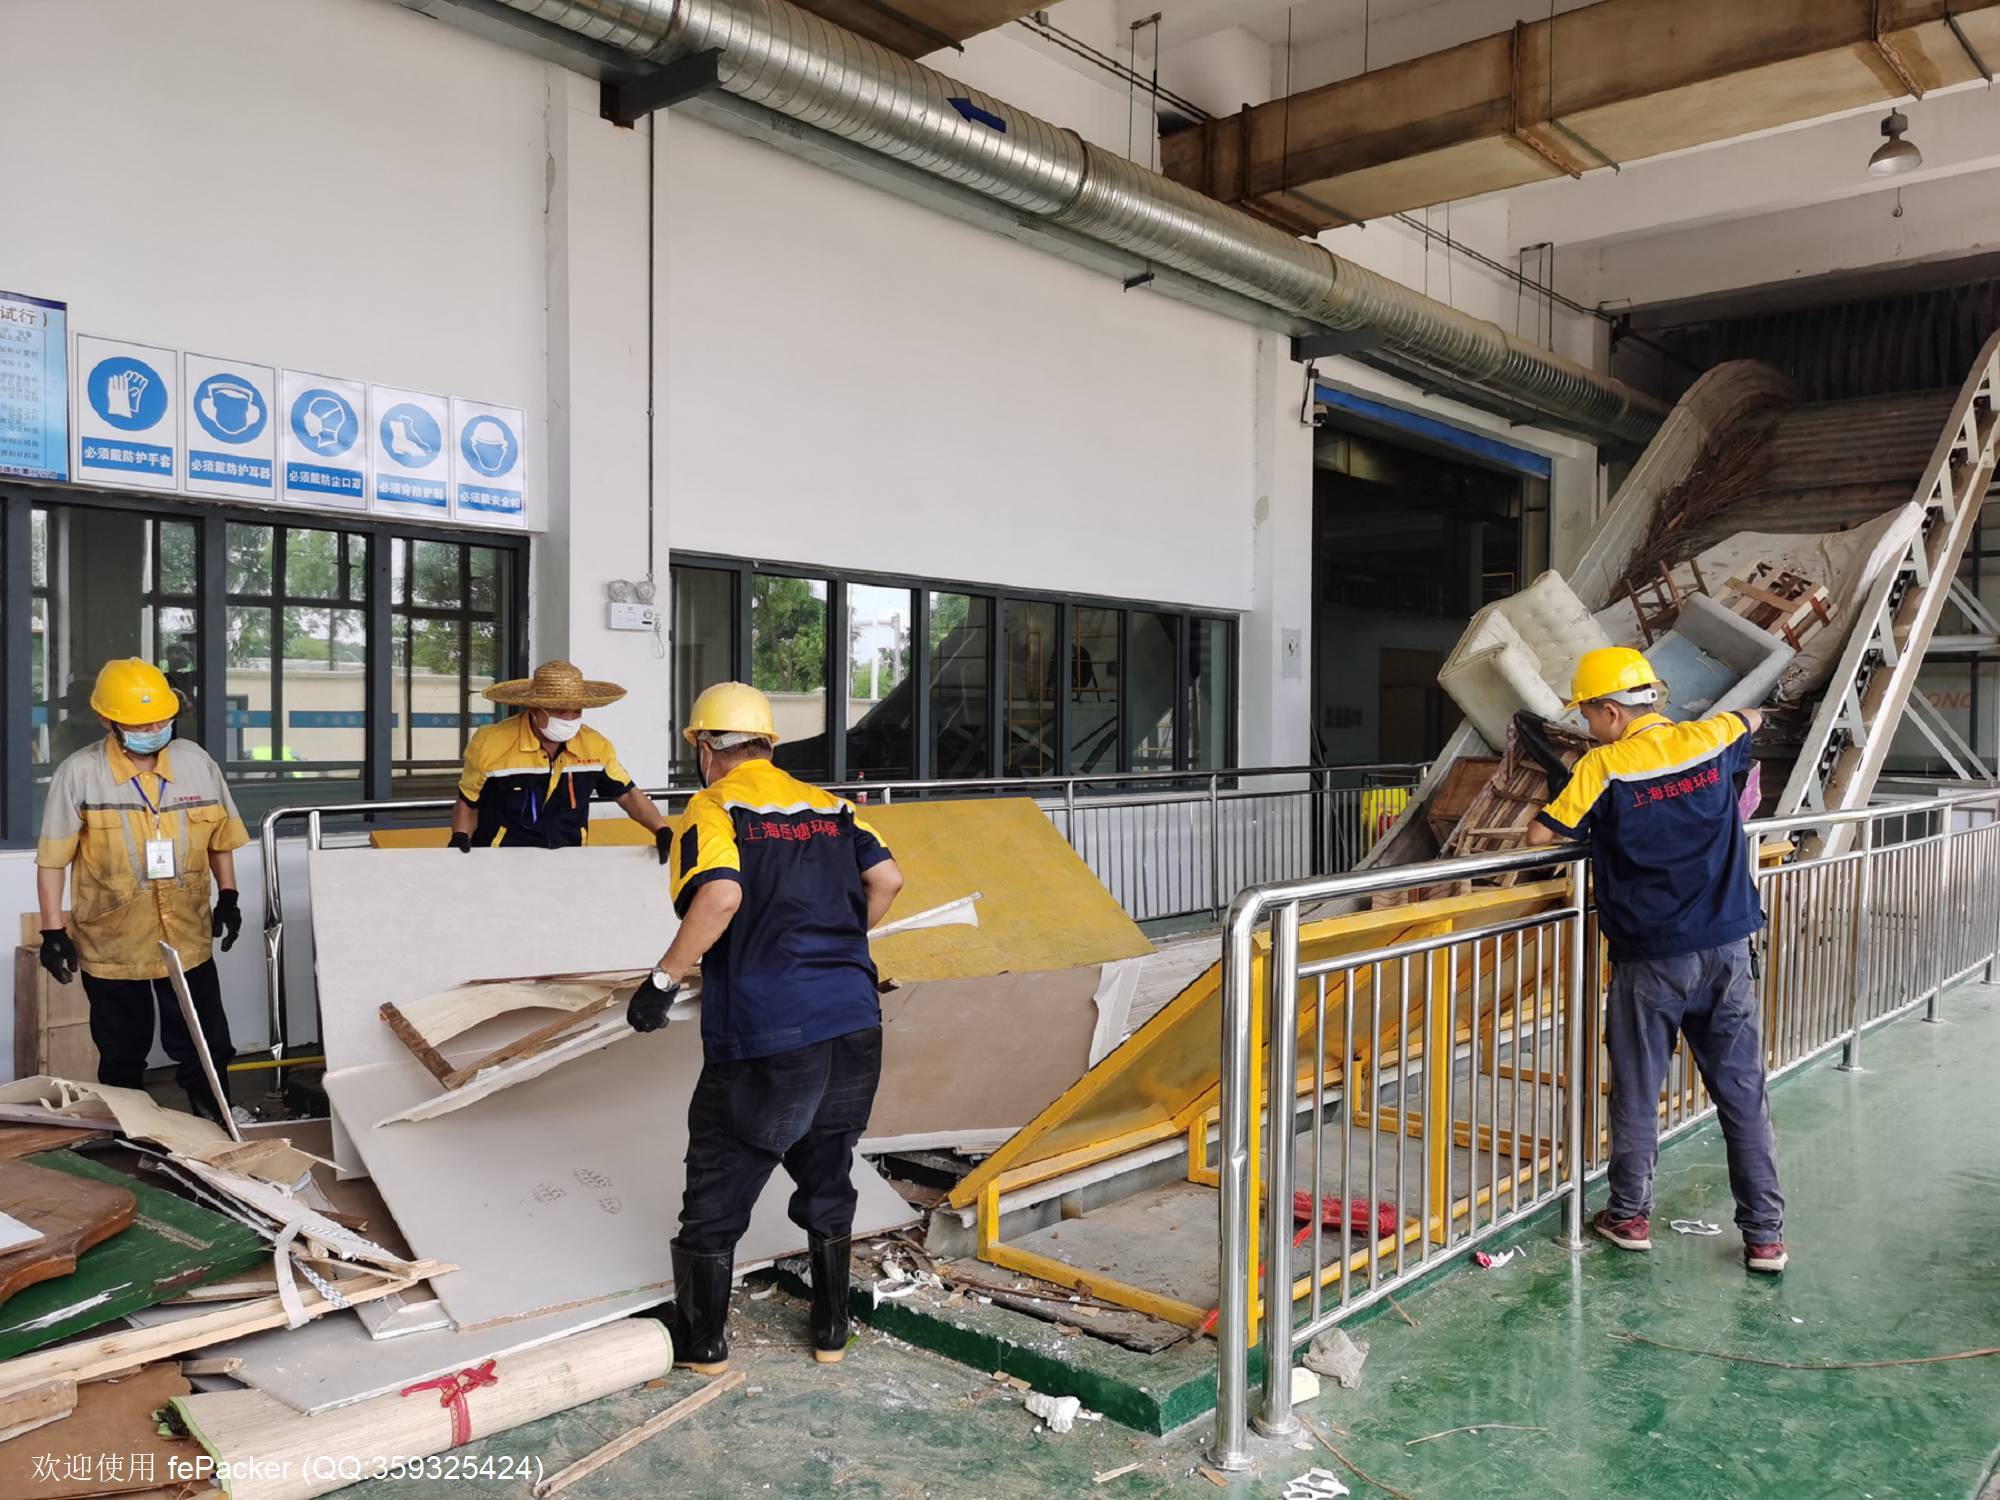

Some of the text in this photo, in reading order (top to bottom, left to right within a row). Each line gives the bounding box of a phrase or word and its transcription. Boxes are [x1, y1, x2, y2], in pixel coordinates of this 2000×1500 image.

[84, 446, 172, 469] 必须戴防护手套
[191, 460, 271, 480] 必须戴防护耳器
[289, 470, 362, 490] 必须戴防尘口罩
[460, 492, 520, 508] 必须戴安全帽
